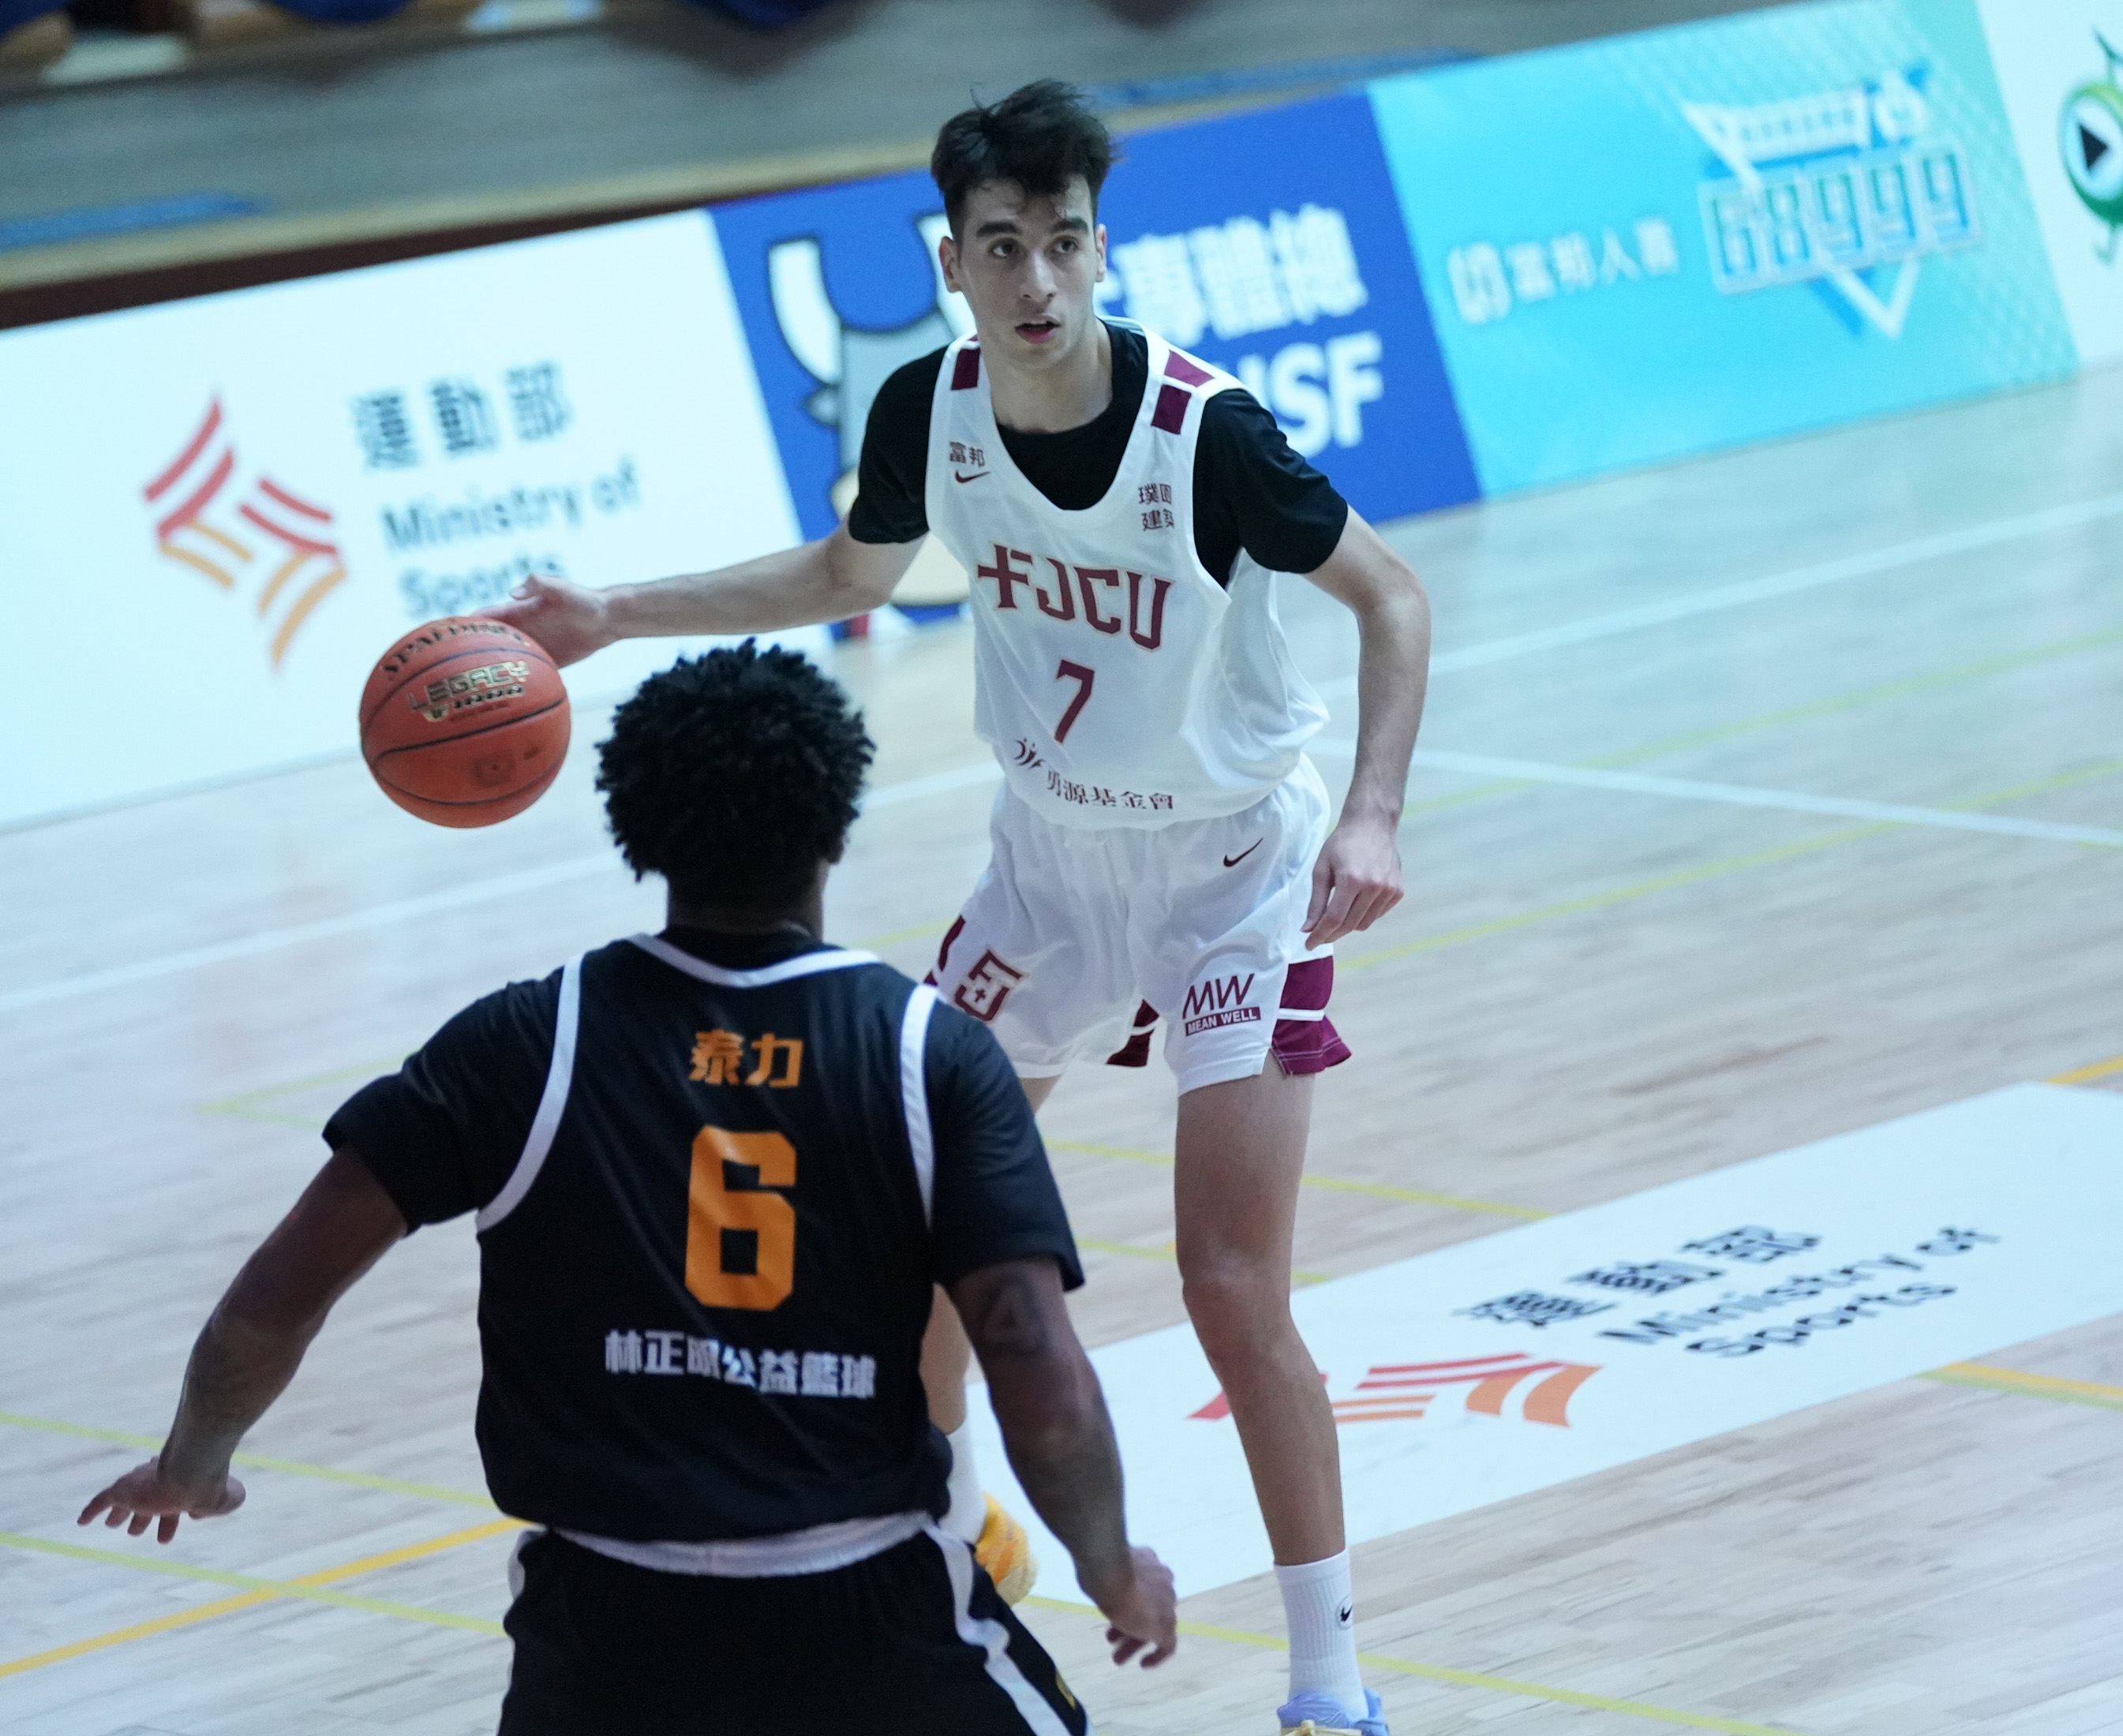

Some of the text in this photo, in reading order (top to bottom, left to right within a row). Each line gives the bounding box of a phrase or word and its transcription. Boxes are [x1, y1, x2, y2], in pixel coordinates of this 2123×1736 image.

[949, 441, 985, 468] 富邦
[379, 455, 641, 552] Ministry of
[976, 543, 1174, 650] FJCU
[406, 660, 530, 712] LEGACY
[1054, 659, 1095, 743] 7
[1182, 973, 1254, 1020] MW
[1187, 1008, 1257, 1035] MEAN WELL
[684, 1125, 796, 1311] 6
